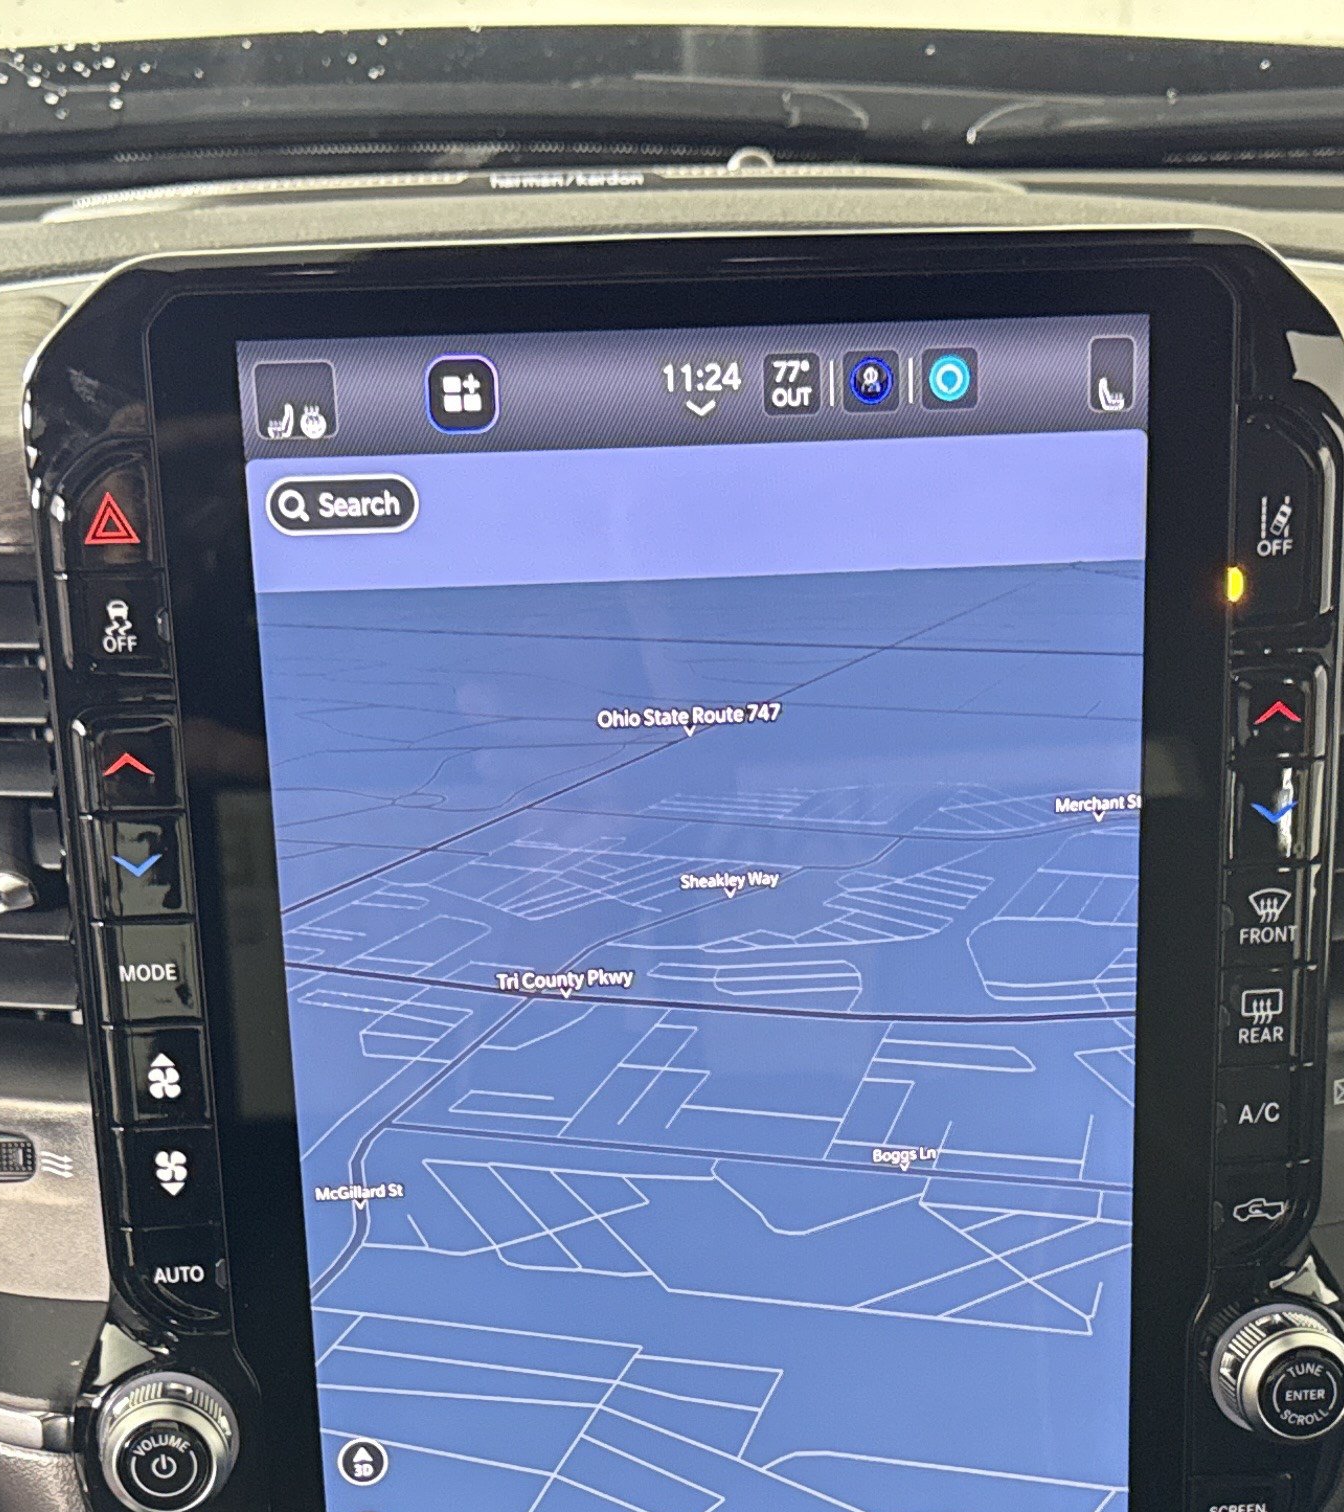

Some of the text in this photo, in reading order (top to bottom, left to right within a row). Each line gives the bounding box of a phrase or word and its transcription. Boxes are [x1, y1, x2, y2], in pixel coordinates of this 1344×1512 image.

[663, 362, 741, 392] 11:24
[772, 361, 810, 383] 77°
[772, 387, 811, 407] OUT
[318, 490, 400, 518] Search
[1257, 539, 1293, 556] OFF
[103, 635, 137, 653] OFF
[597, 703, 781, 728] Ohio State Route 747
[1055, 796, 1125, 813] Merchant
[680, 871, 779, 889] Sheakley Way
[1239, 924, 1297, 945] FRONT
[119, 963, 178, 982] MODE
[496, 968, 633, 990] Tri County Pkwy
[1238, 1027, 1283, 1044] REAR
[1238, 1102, 1280, 1124] A/C
[873, 1147, 936, 1164] Boggs Ln
[315, 1183, 403, 1200] McGillard St
[154, 1266, 205, 1284] AUTO
[1286, 1364, 1324, 1378] TUNE
[1285, 1388, 1325, 1402] ENTER
[1280, 1409, 1329, 1426] SCROLL
[133, 1434, 191, 1456] VOLUME
[354, 1463, 374, 1478] 3D
